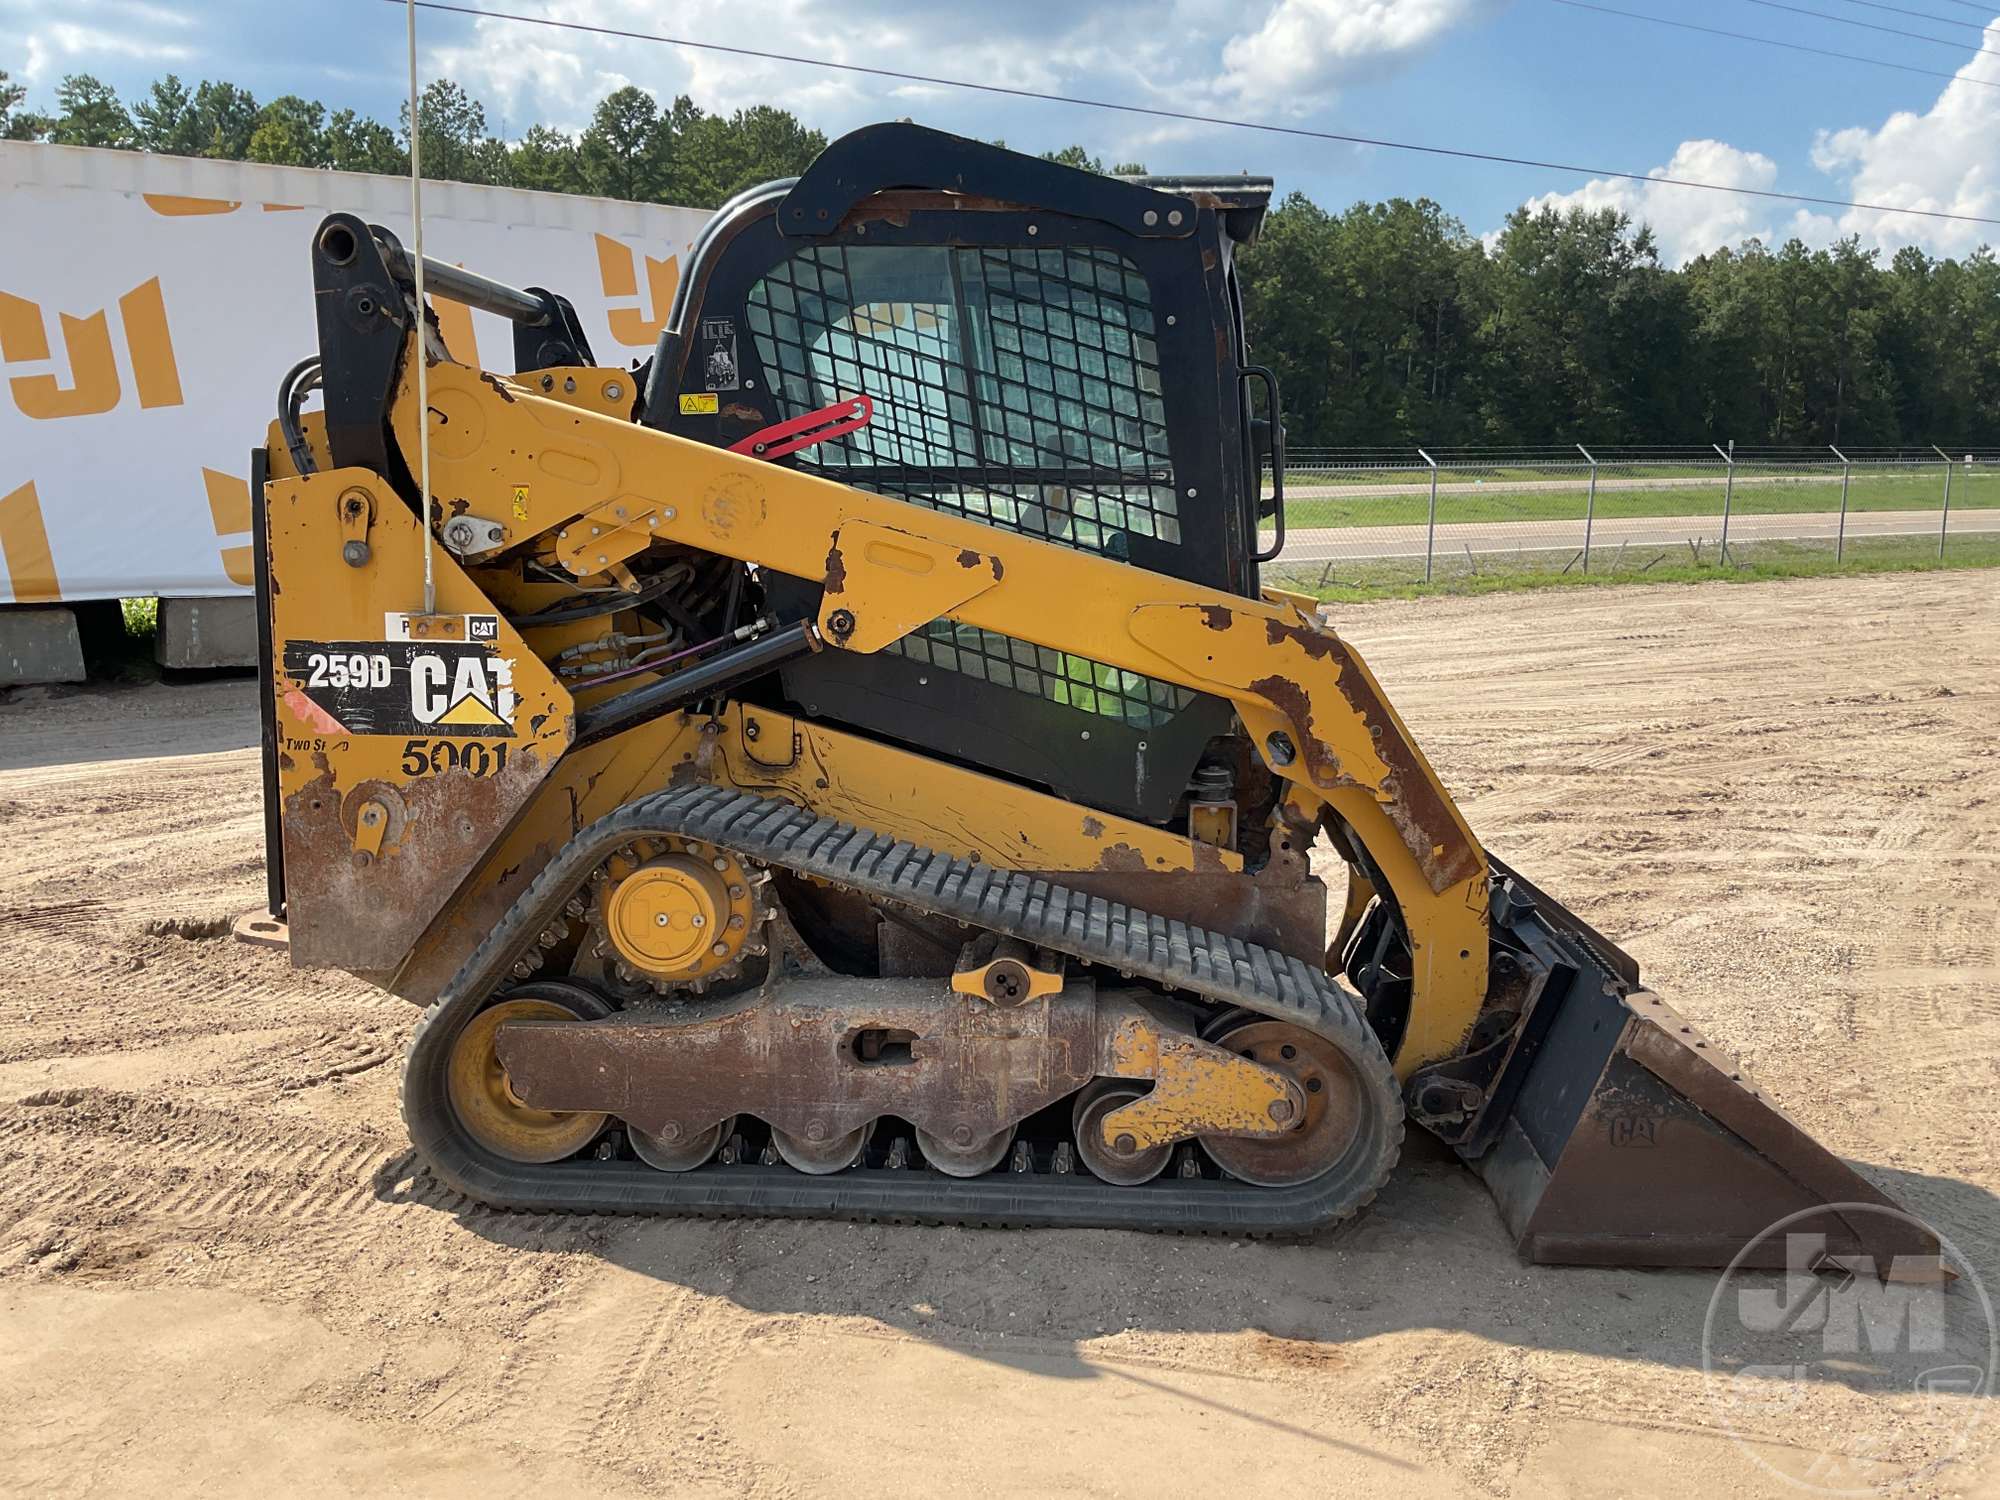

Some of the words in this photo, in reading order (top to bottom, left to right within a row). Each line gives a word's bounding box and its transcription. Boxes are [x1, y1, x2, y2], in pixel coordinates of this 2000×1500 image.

[472, 621, 497, 636] CAT
[308, 654, 391, 688] 259D
[410, 655, 517, 725] CAT
[401, 739, 537, 778] 5001
